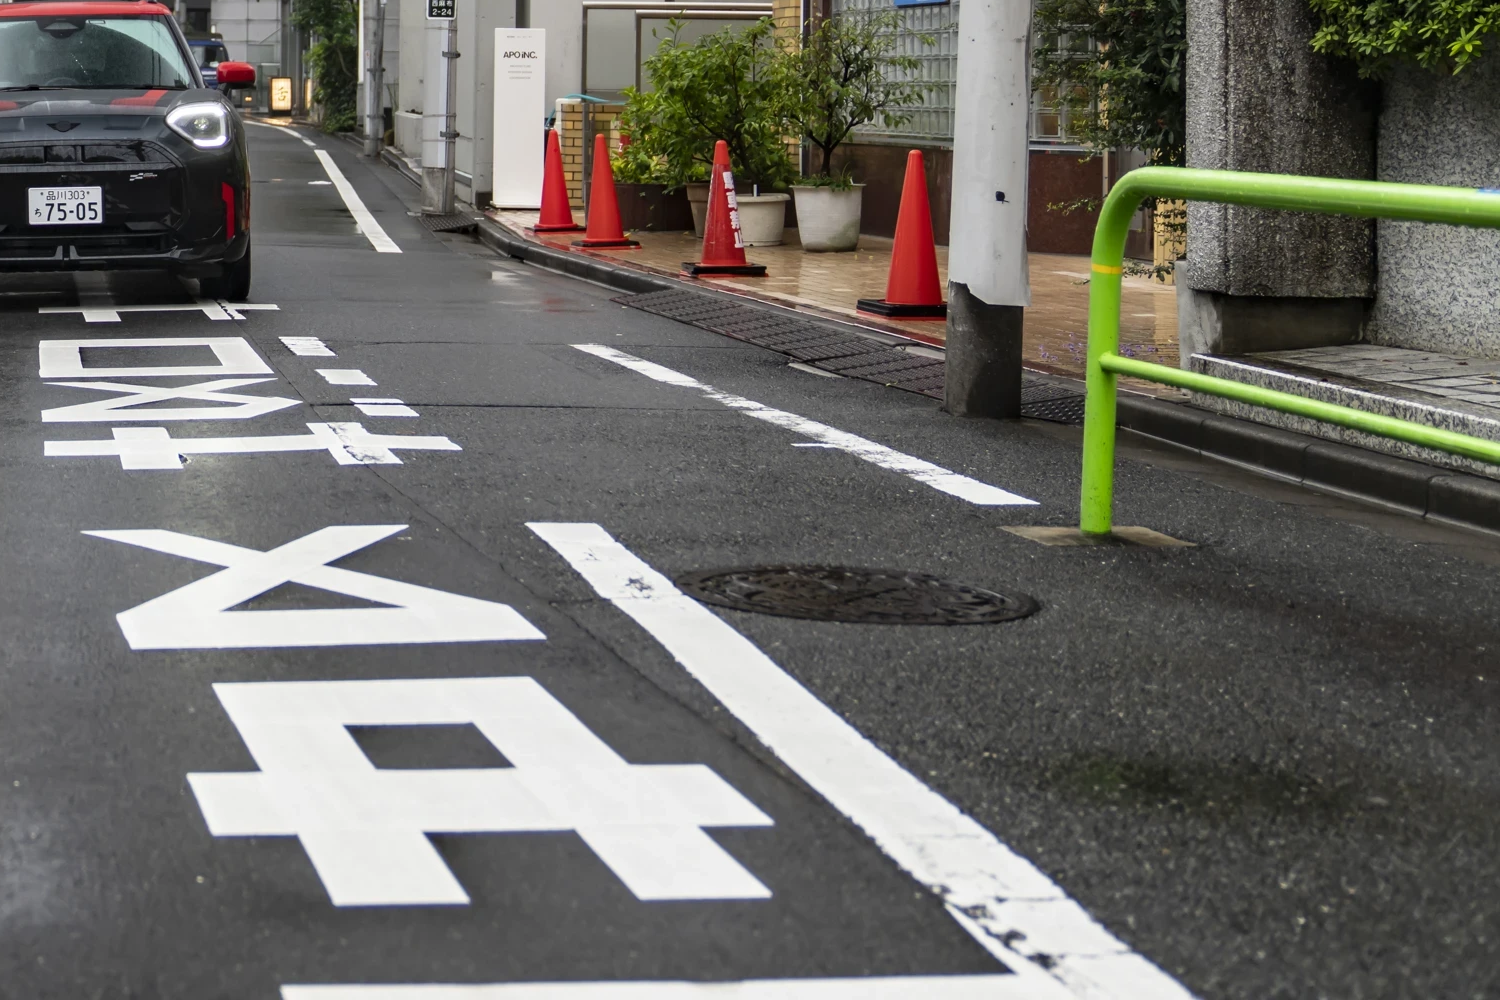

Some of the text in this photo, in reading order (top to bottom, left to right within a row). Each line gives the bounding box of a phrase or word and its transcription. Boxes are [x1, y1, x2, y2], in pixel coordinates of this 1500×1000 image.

[432, 8, 452, 16] 2-24
[503, 51, 521, 59] APO
[34, 202, 98, 222] ち 75-05
